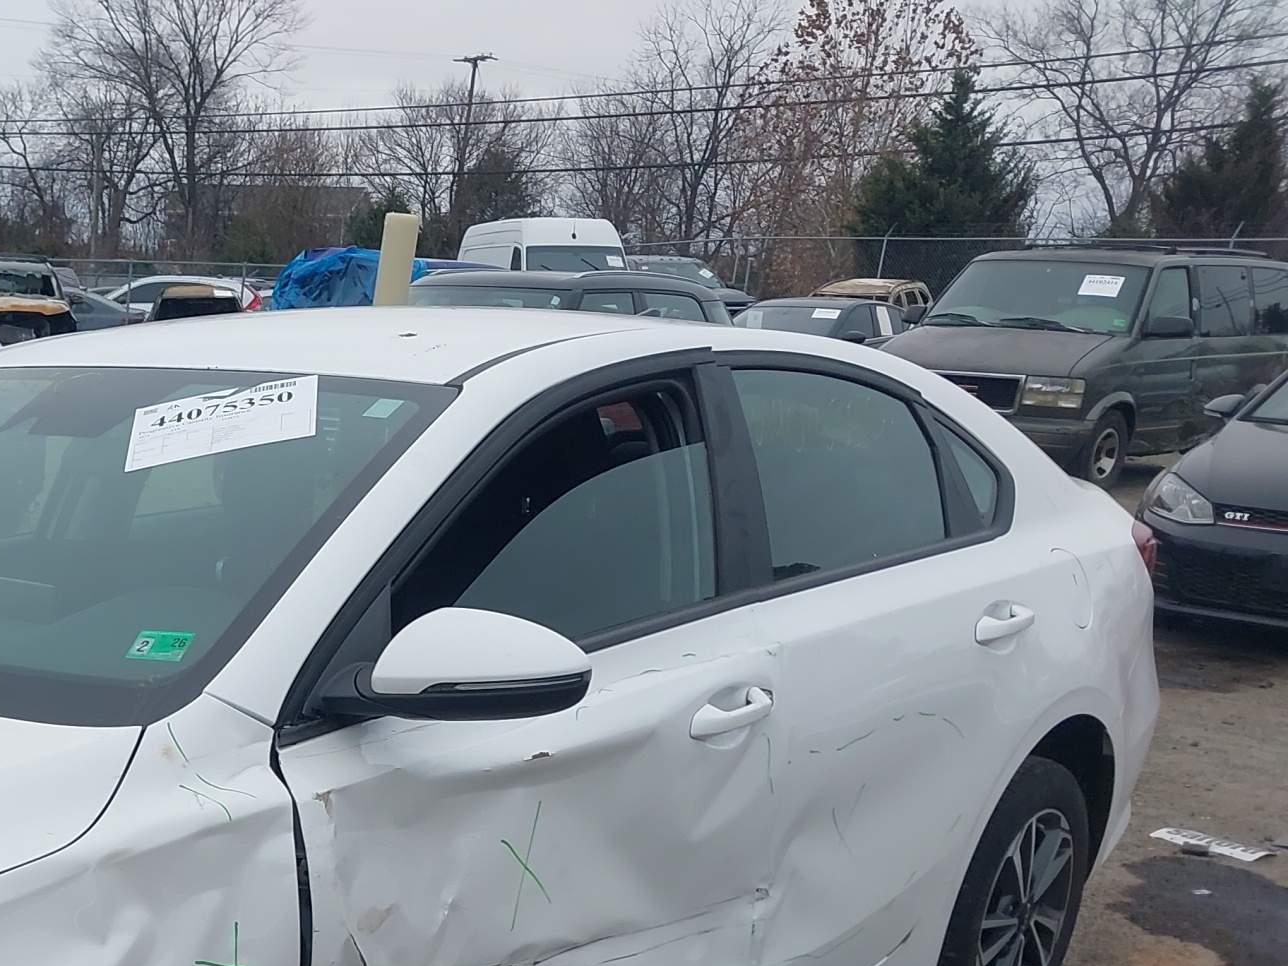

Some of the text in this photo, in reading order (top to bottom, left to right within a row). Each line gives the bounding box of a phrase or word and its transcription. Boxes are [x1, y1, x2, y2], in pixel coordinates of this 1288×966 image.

[149, 390, 294, 429] 44075350
[1223, 511, 1251, 521] GTI
[135, 637, 188, 653] 2 26
